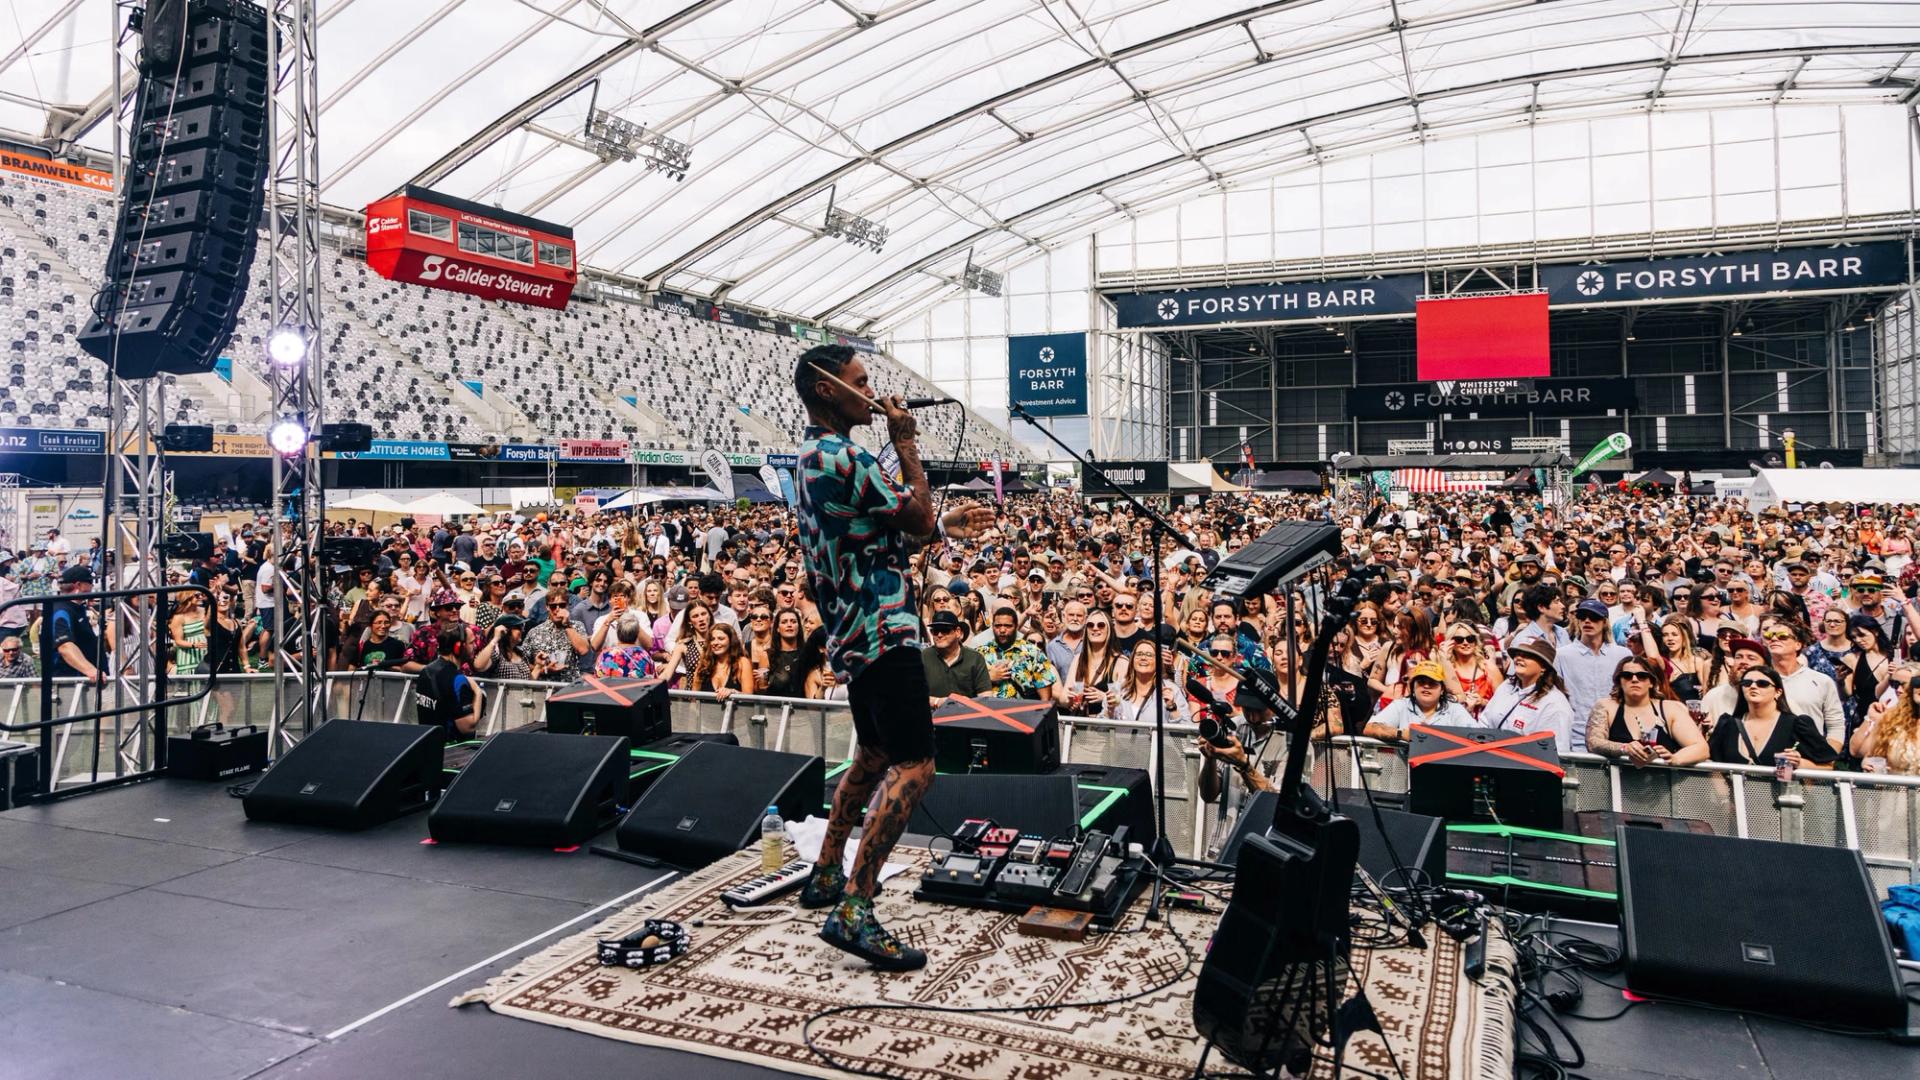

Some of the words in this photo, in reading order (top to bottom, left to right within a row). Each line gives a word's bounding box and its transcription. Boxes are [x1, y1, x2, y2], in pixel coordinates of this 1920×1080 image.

[1, 155, 82, 181] BRAMWELL
[31, 177, 65, 188] BRAMWELL
[380, 218, 399, 226] Calder
[380, 223, 402, 231] Stewart
[1615, 263, 1760, 290] FORSYTH
[1772, 256, 1863, 281] BARR
[444, 264, 496, 288] Calder
[495, 276, 554, 299] Stewart
[1187, 292, 1298, 315] FORSYTH
[1307, 288, 1375, 308] BARR
[658, 301, 690, 316] washco
[1019, 367, 1076, 379] FORSYTH
[1031, 380, 1065, 391] BARR
[1459, 380, 1518, 388] WHITESTONE
[1460, 387, 1493, 395] CHEESE
[1413, 391, 1518, 407] FORSYTH
[1527, 387, 1591, 404] BARR
[43, 435, 60, 444] Cook
[64, 436, 96, 446] Brothers
[1443, 440, 1502, 450] MOONS
[411, 446, 445, 456] HOMES
[506, 448, 537, 461] Forsyth
[571, 446, 583, 457] VIP
[584, 447, 620, 457] EXPERIENCE
[663, 452, 684, 463] Glass
[744, 454, 761, 465] Glass
[769, 456, 786, 465] Forsyth
[786, 456, 797, 465] Barr
[1134, 469, 1146, 483] up
[1270, 693, 1299, 720] FIRTH
[234, 764, 250, 773] FLAME
